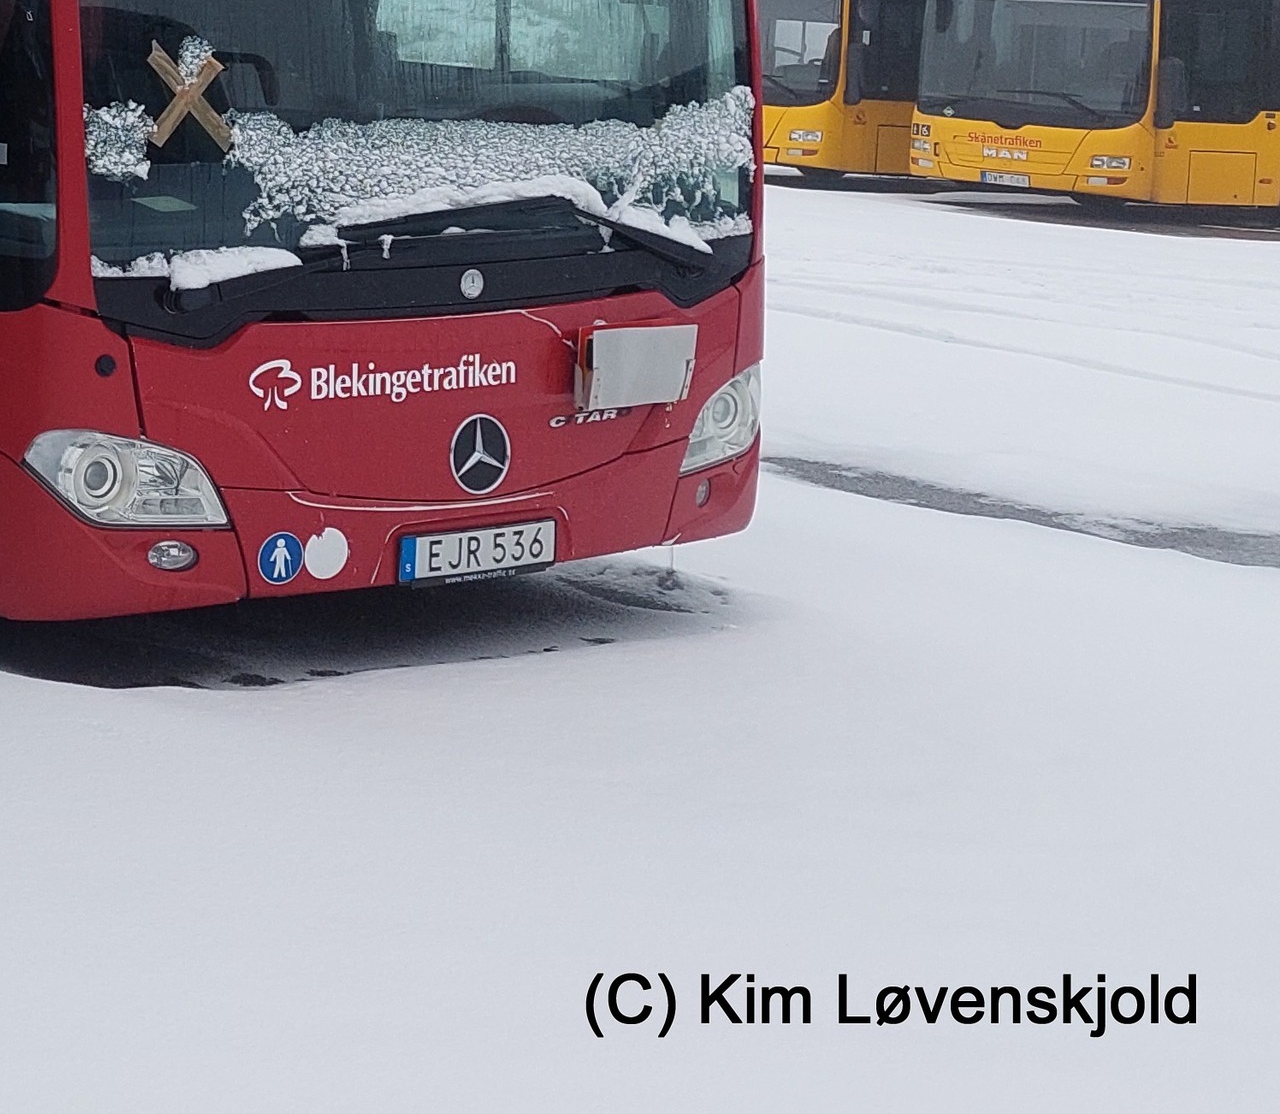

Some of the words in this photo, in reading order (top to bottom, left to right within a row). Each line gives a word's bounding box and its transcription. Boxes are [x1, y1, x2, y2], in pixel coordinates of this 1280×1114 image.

[967, 132, 1042, 148] Skånetrafiken
[983, 146, 1028, 161] MAN
[310, 353, 516, 403] Blekingetrafiken
[428, 536, 481, 572] EJR
[492, 527, 544, 564] 536
[405, 563, 412, 572] S
